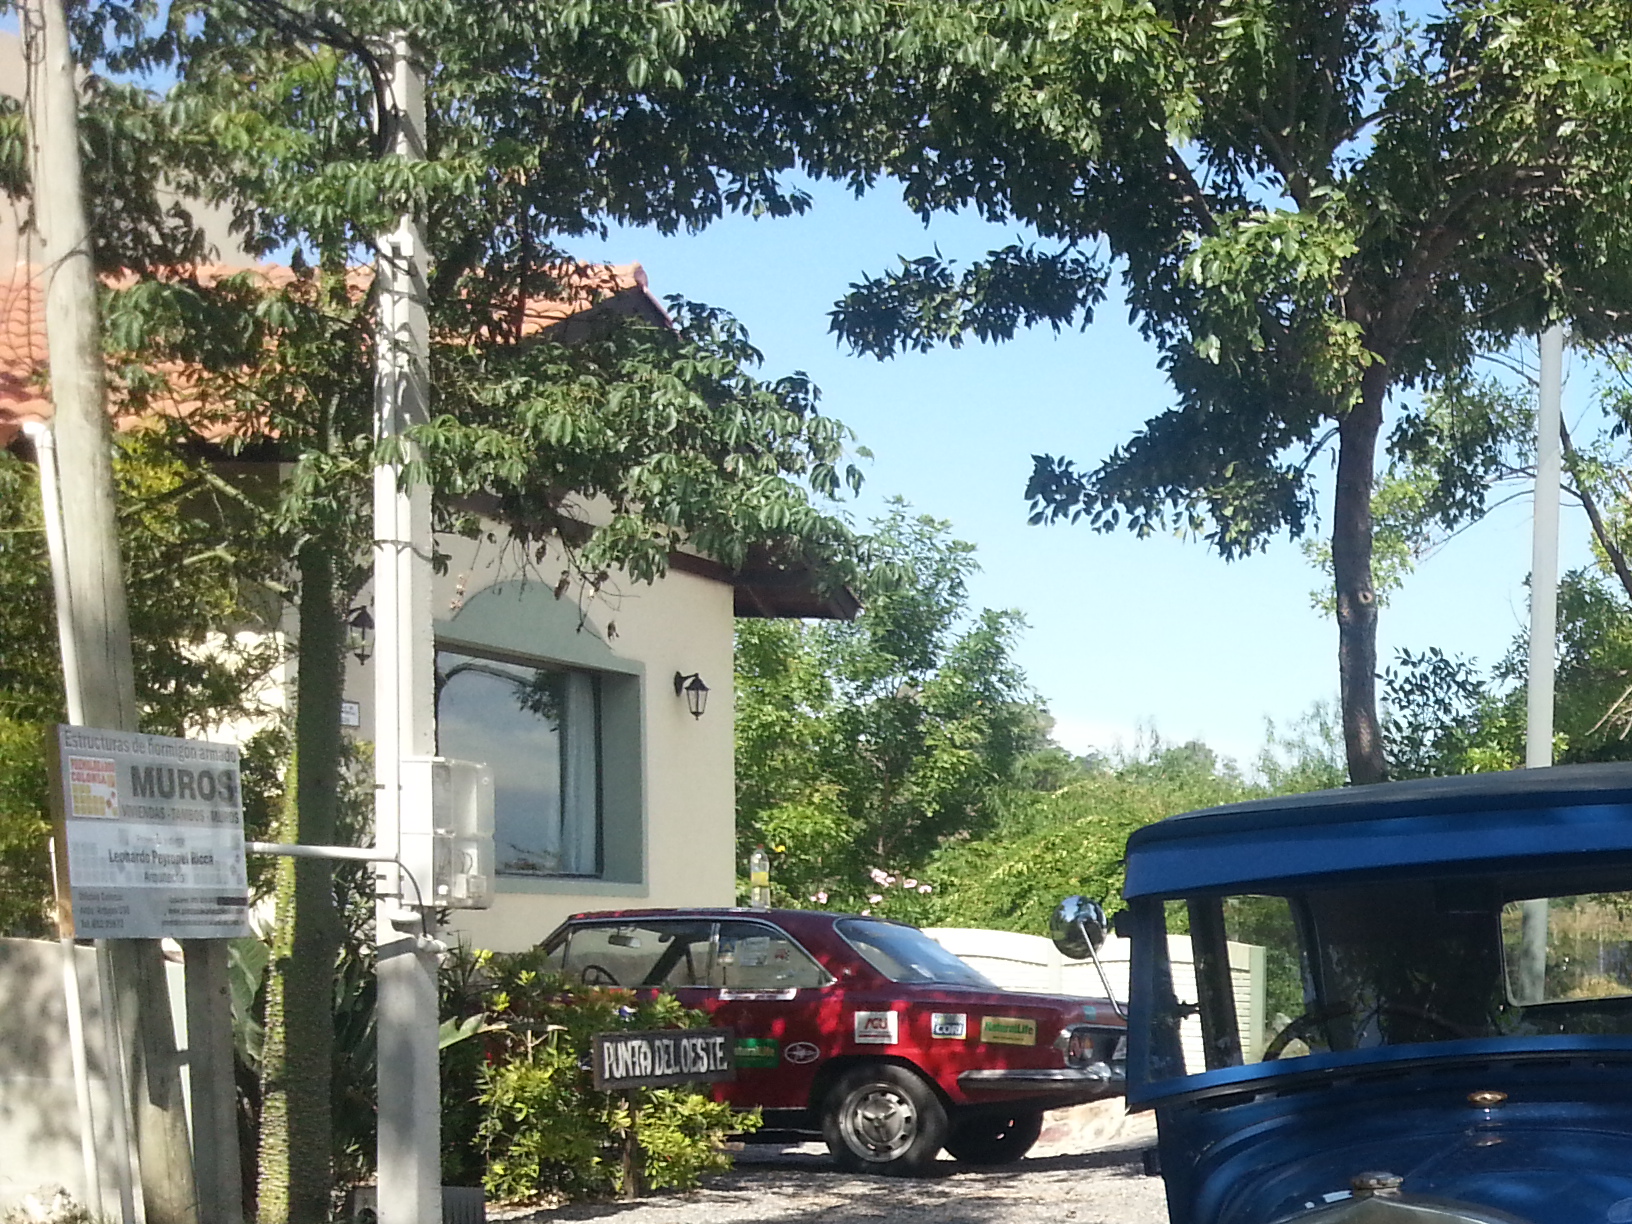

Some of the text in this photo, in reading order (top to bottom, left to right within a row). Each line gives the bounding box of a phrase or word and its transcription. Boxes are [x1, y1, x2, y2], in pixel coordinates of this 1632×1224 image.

[65, 730, 130, 752] Estructuras
[132, 737, 146, 754] de
[199, 746, 237, 764] armado
[130, 764, 236, 805] MUROS
[603, 1035, 729, 1079] PUNTA DEL OESTE
